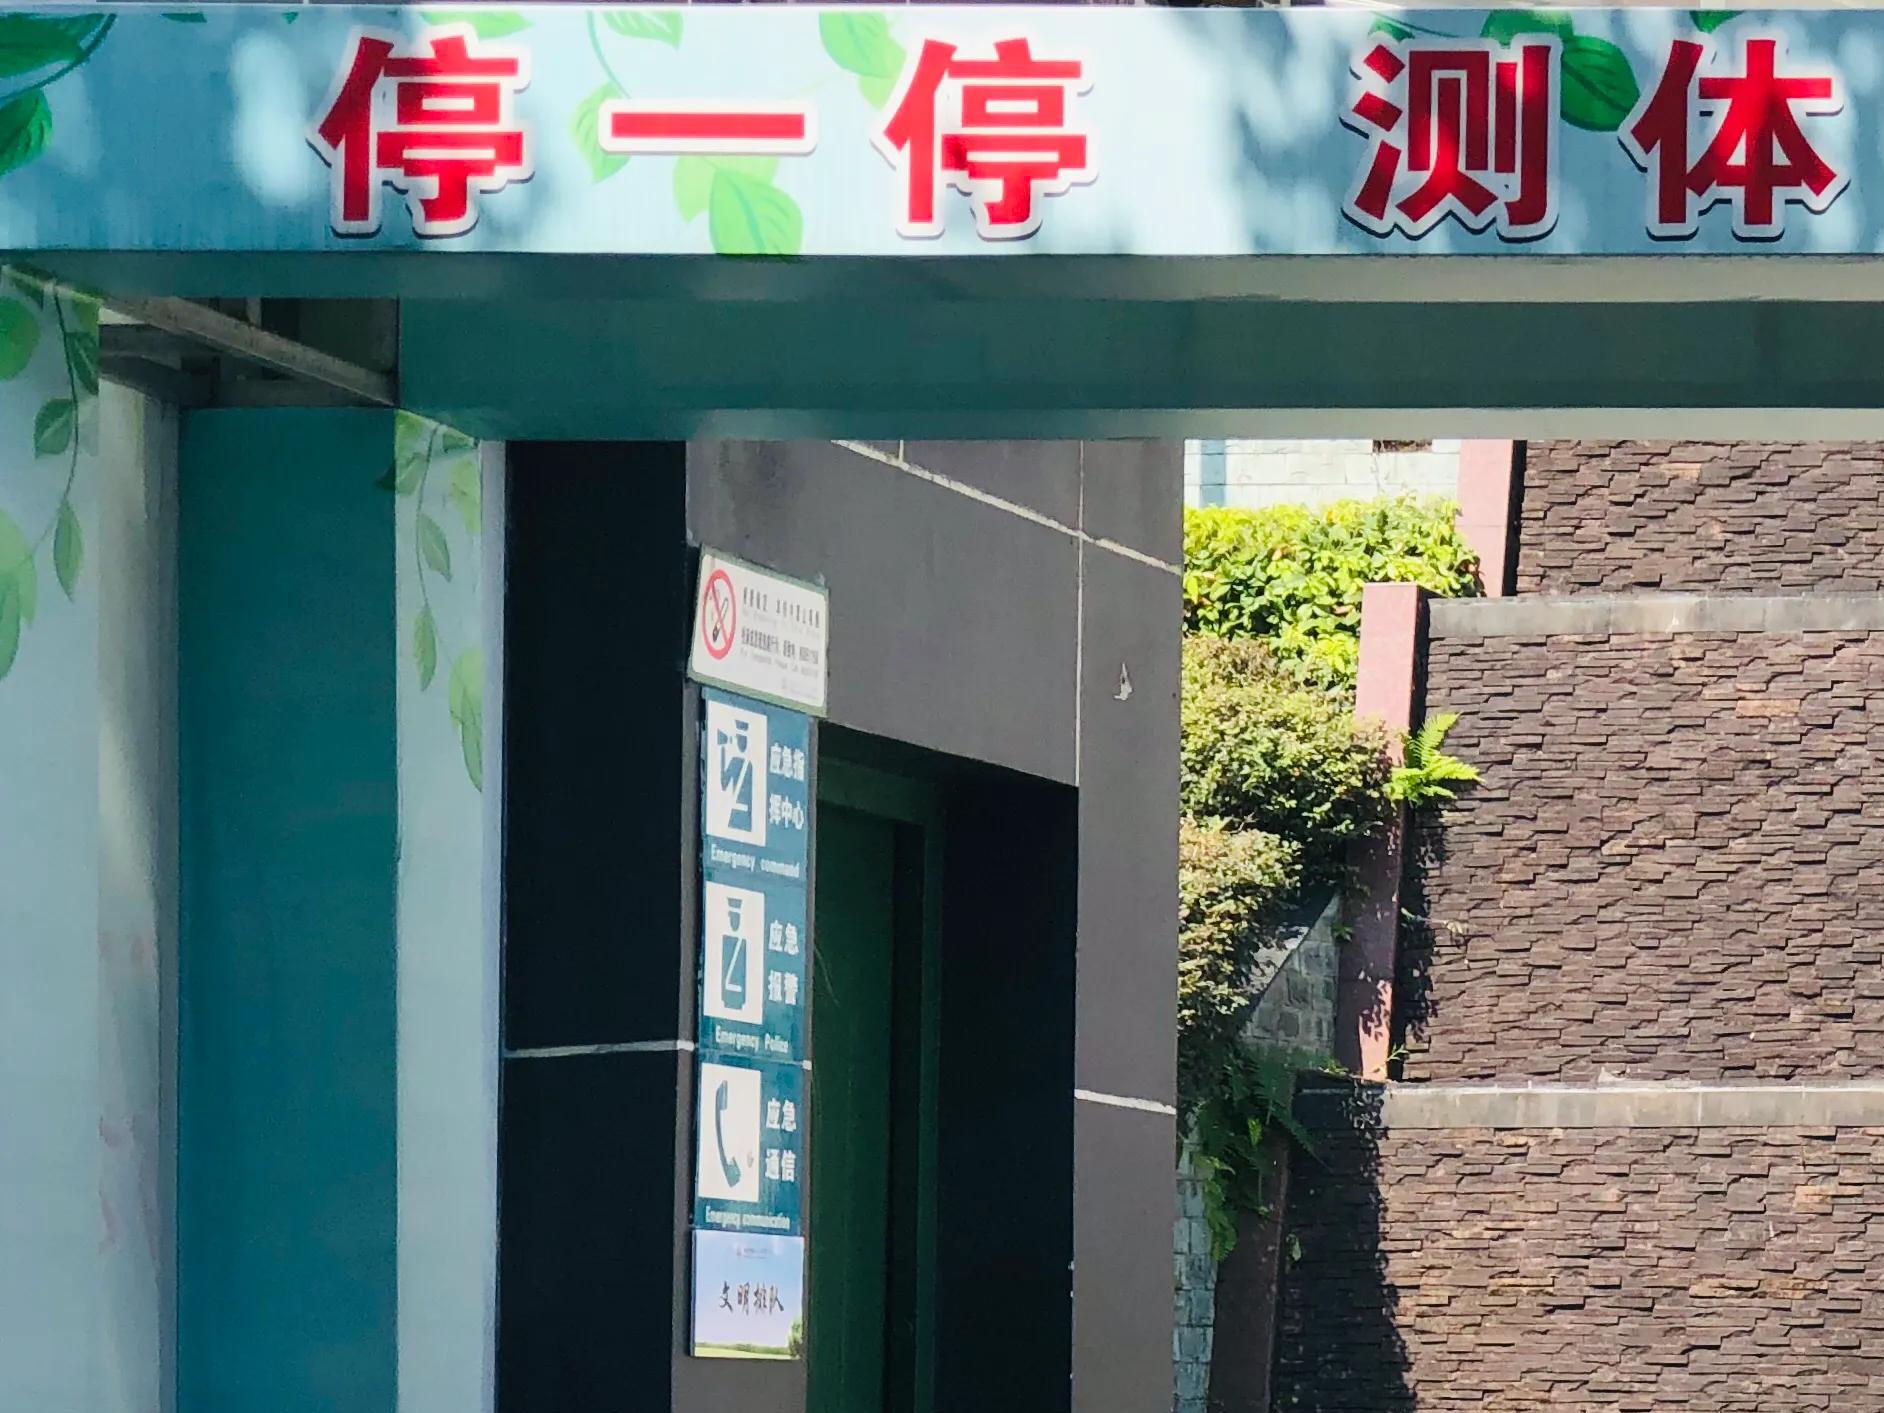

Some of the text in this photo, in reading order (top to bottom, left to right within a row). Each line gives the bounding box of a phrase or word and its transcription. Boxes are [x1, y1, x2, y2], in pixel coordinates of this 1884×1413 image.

[317, 33, 1089, 227] 停一停
[711, 843, 756, 872] Emergency
[768, 919, 799, 956] 应急
[715, 1024, 760, 1053] Emergency
[765, 1097, 797, 1133] 应急
[764, 1148, 797, 1183] 通信
[705, 1205, 741, 1231] Emergency
[719, 1280, 785, 1316] 文明排队
